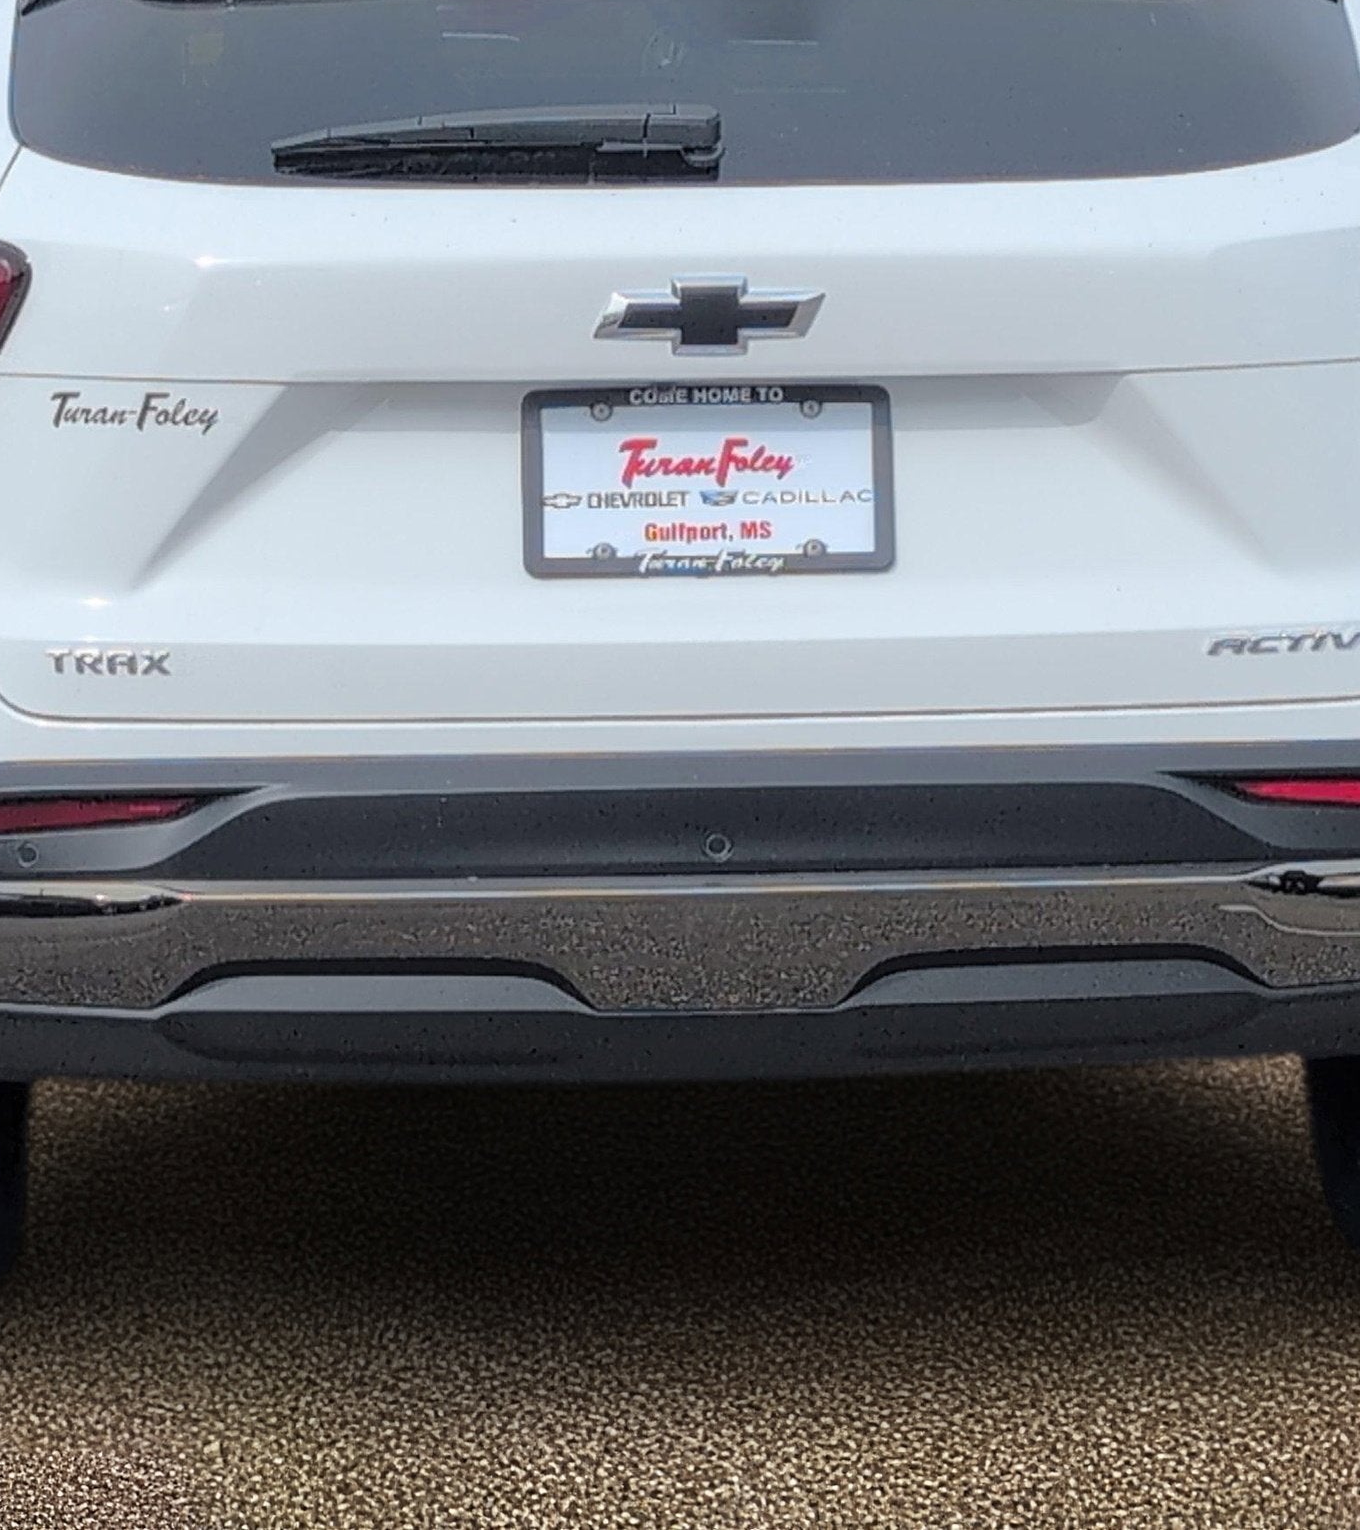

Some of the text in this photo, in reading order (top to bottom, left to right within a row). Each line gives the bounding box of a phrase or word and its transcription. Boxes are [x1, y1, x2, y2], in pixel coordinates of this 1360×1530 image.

[629, 386, 784, 405] COME HOME TO
[587, 490, 691, 509] CHEVROLET
[742, 488, 873, 506] CADILLAC
[644, 520, 773, 545] Gulfport, MS
[46, 649, 172, 676] TRAX
